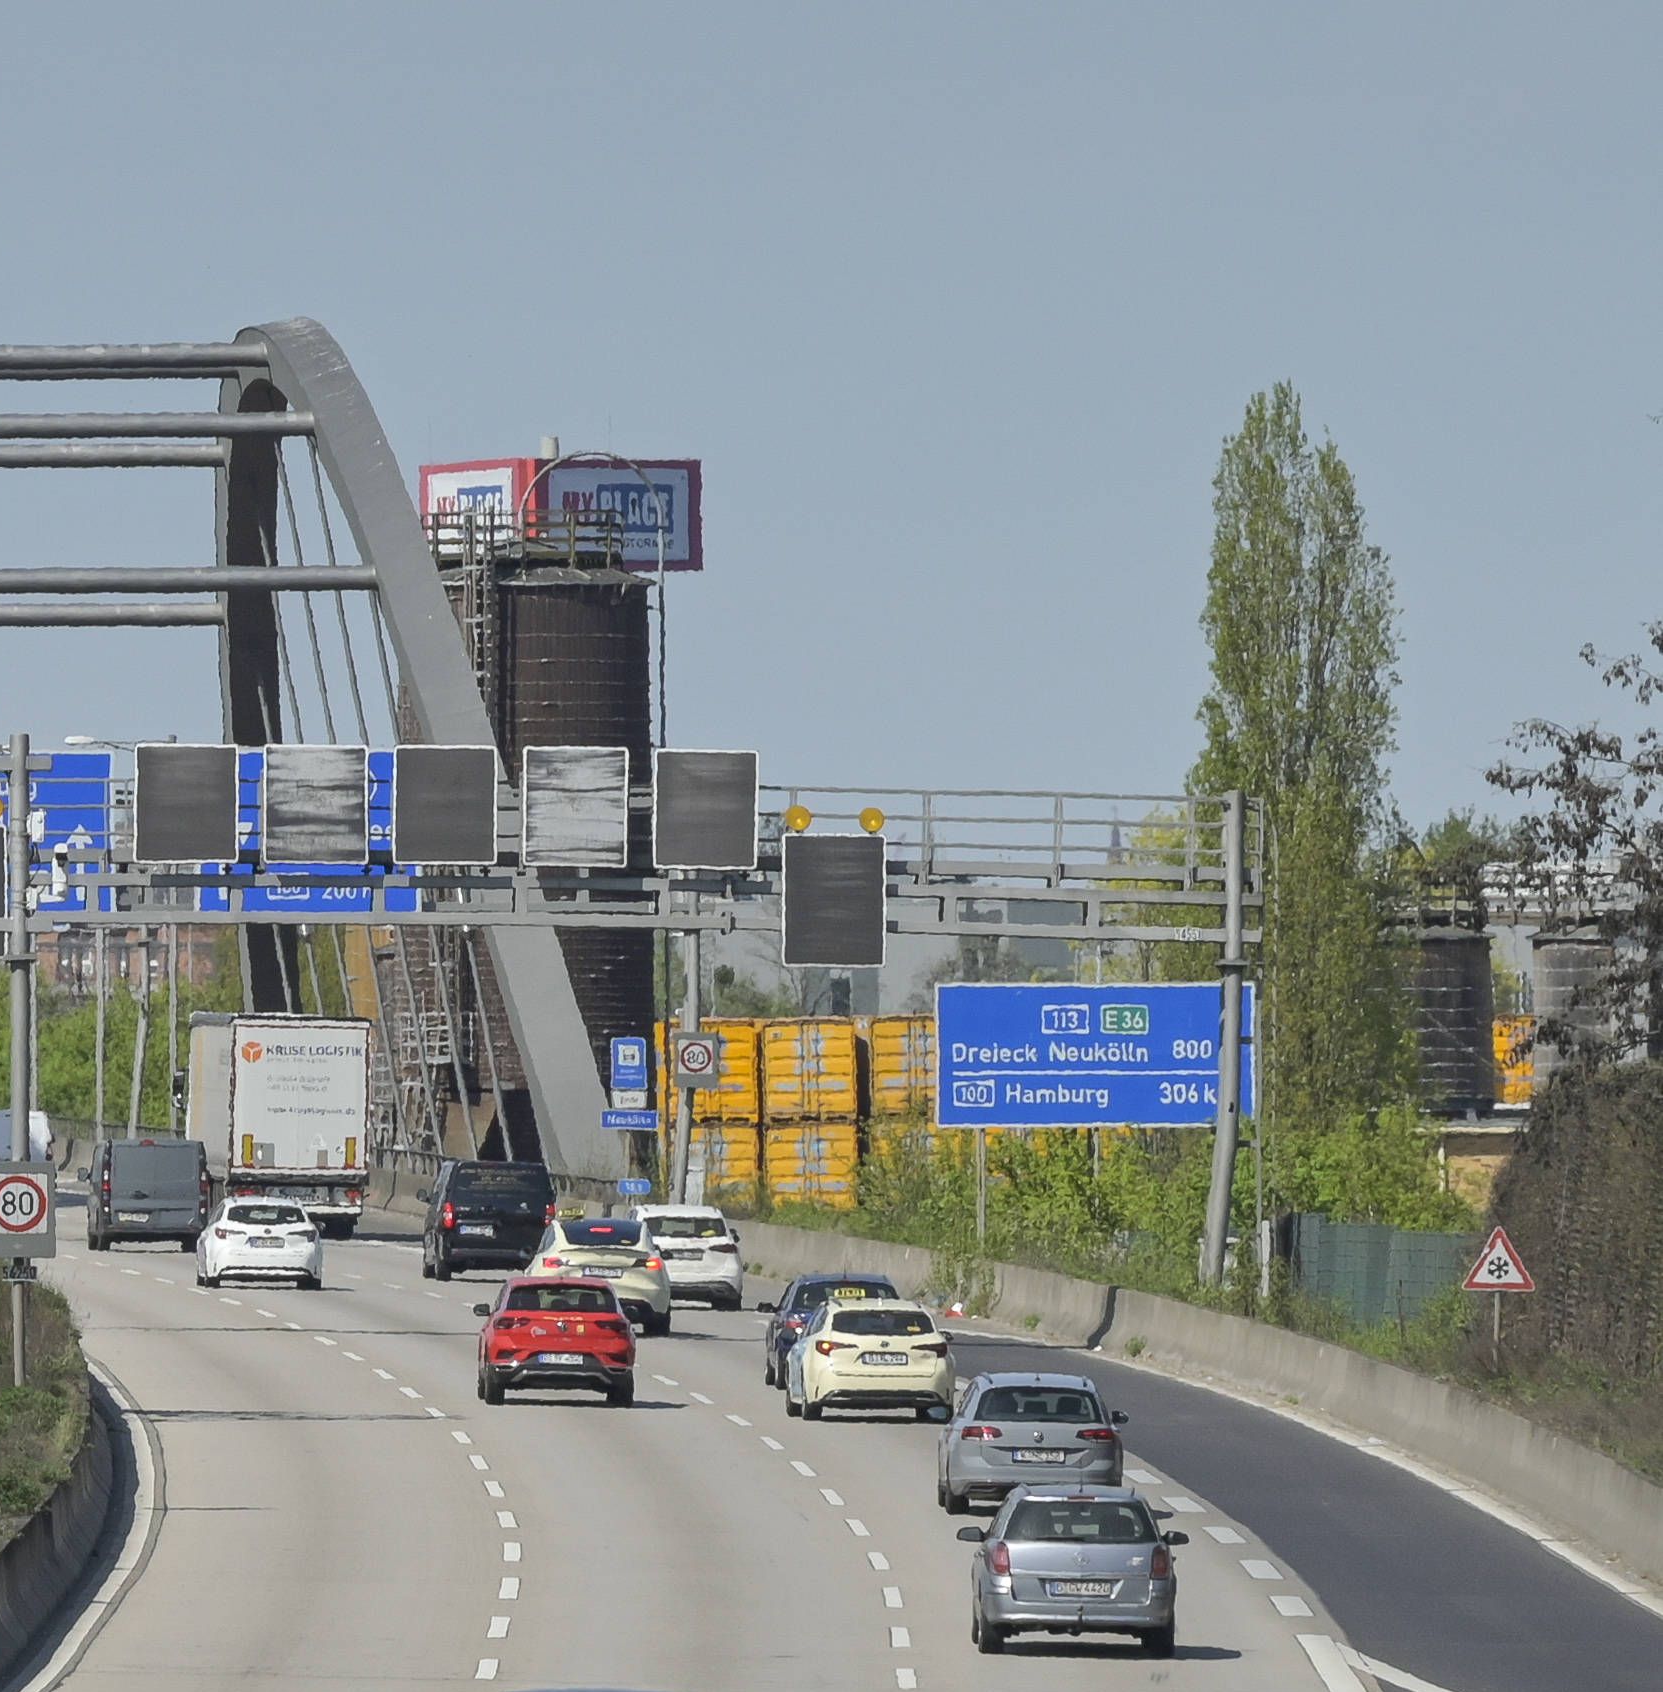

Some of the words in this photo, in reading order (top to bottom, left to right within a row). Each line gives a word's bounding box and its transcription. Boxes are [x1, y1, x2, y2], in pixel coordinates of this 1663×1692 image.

[1052, 1011, 1079, 1029] 113
[1105, 1011, 1117, 1030] E
[1122, 1011, 1144, 1030] 36
[266, 1045, 306, 1057] KRUSE
[309, 1045, 363, 1058] LOGISTIK
[687, 1050, 705, 1066] 80
[952, 1042, 1038, 1064] Dreieck
[1049, 1040, 1149, 1063] Neukölln
[1172, 1039, 1212, 1061] 800
[959, 1085, 988, 1104] 100
[1006, 1082, 1109, 1109] Hamburg
[1159, 1082, 1199, 1105] 306
[1204, 1082, 1218, 1104] k
[1, 1190, 34, 1217] 80
